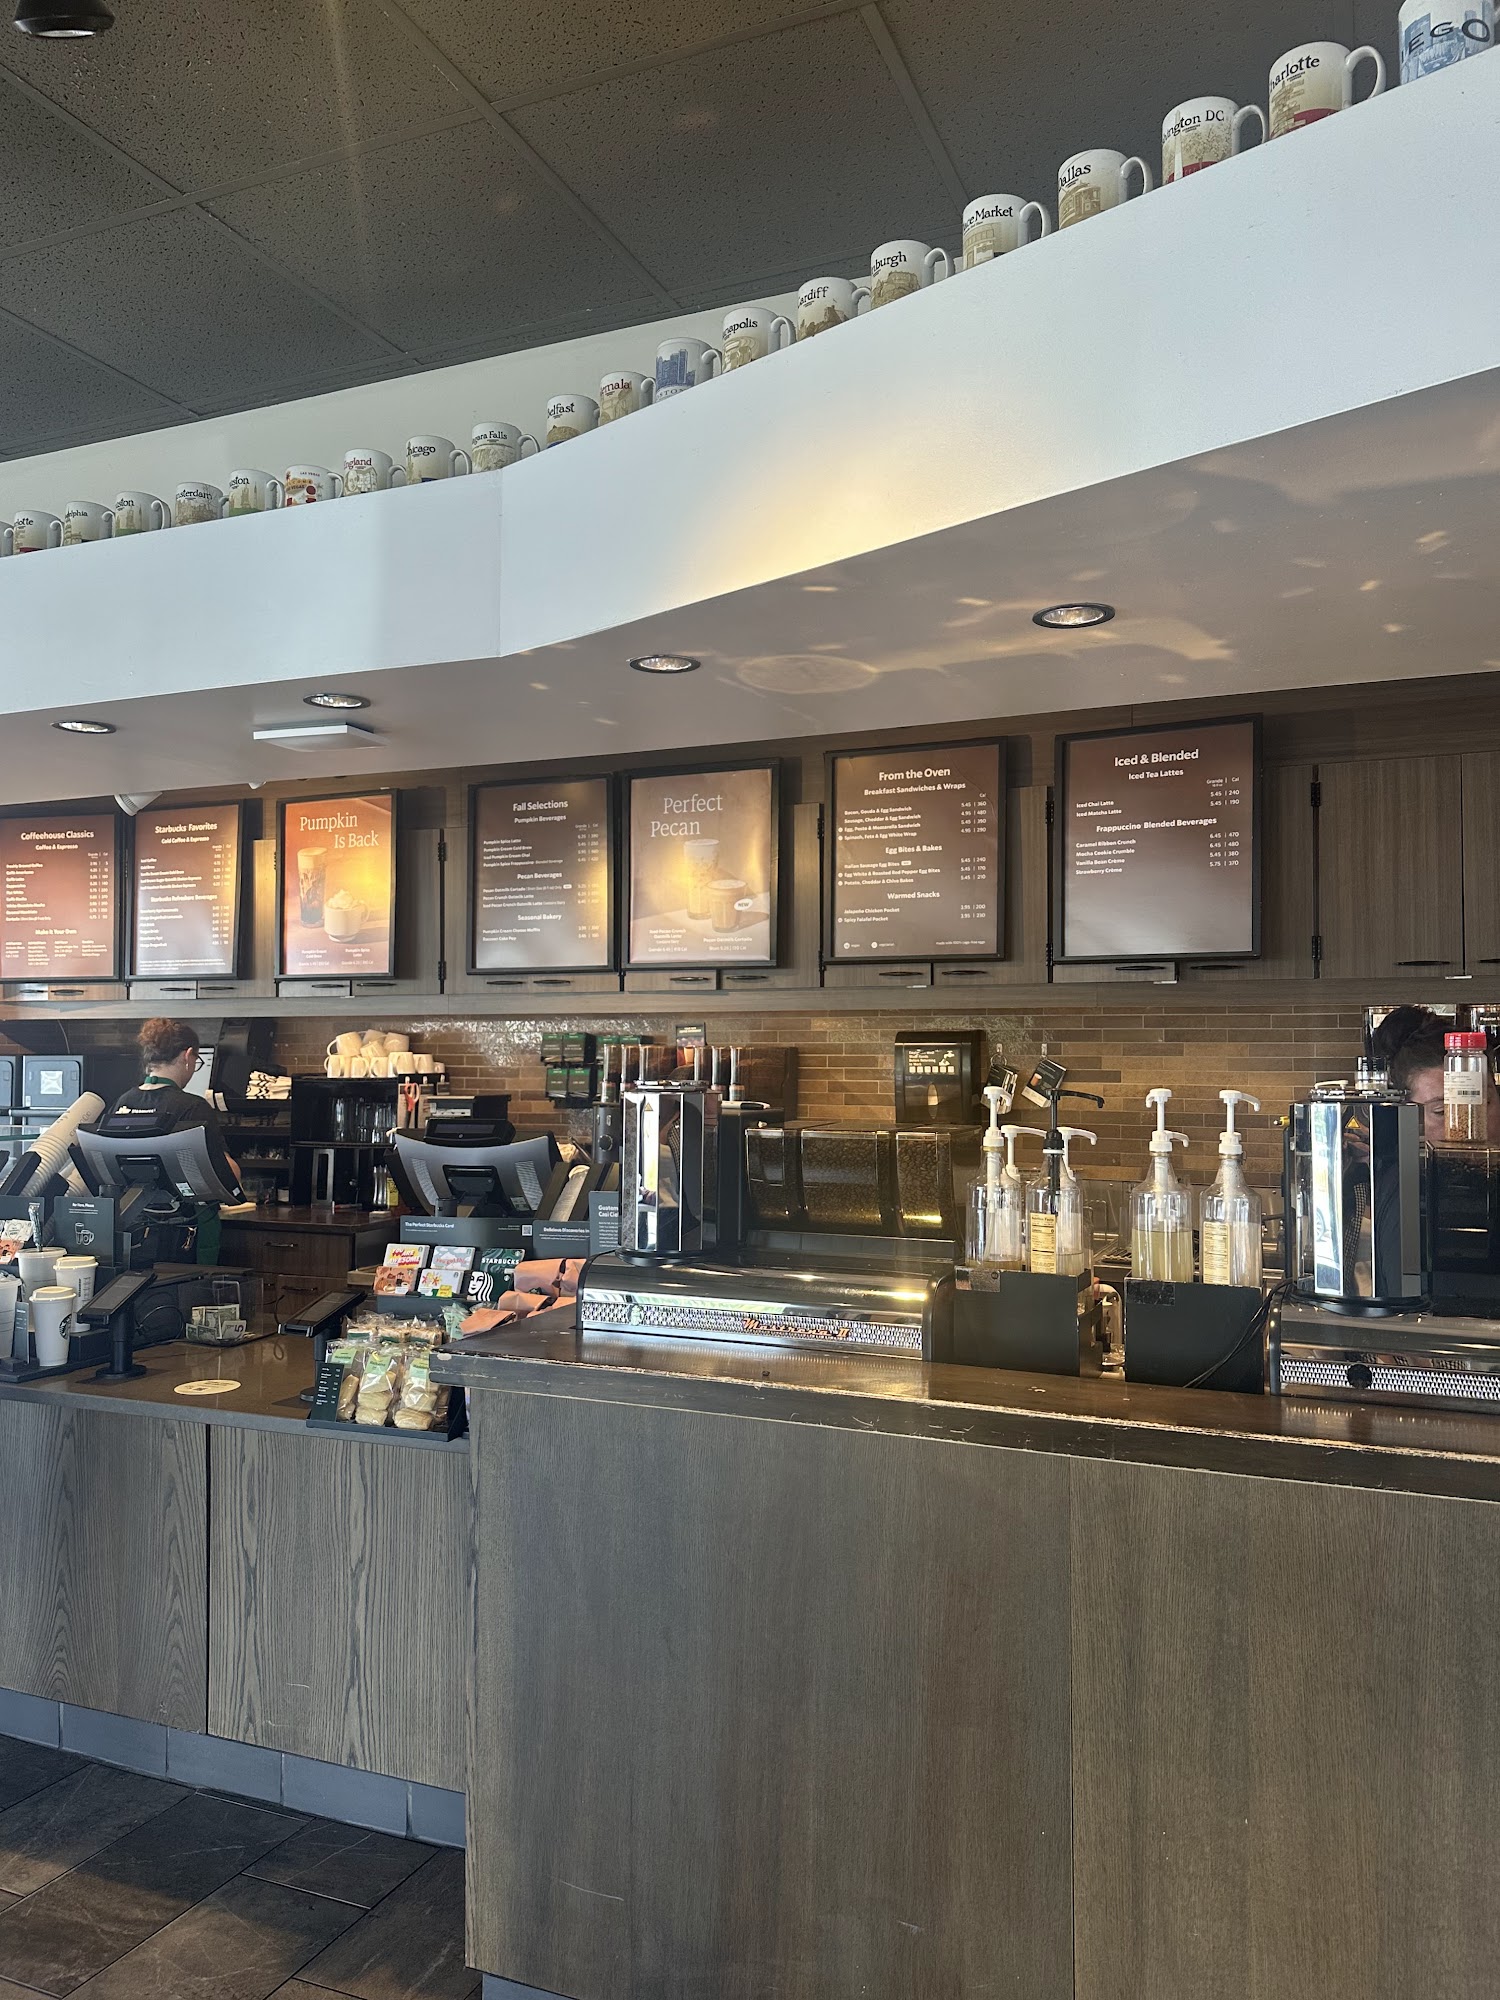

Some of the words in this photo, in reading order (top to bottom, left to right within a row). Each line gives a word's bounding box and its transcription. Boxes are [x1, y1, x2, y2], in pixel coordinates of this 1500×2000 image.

[1205, 110, 1225, 121] DC
[974, 204, 1014, 221] Market
[489, 431, 508, 440] Falls
[1114, 754, 1138, 767] Iced
[1140, 754, 1149, 764] &
[1151, 749, 1200, 763] Blended
[879, 772, 904, 781] From
[906, 769, 923, 778] the
[924, 768, 951, 778] Oven
[1128, 772, 1145, 780] Iced
[1146, 770, 1159, 778] Tea
[864, 787, 896, 796] Breakfast
[896, 783, 936, 794] Sandwiches
[512, 802, 526, 812] Fall
[527, 800, 568, 810] Selections
[664, 794, 723, 814] Perfect
[300, 812, 358, 832] Pumpkin
[514, 816, 538, 824] Pumpkin
[1096, 823, 1142, 833] Frappuccino
[1144, 820, 1176, 829] Blended
[1176, 818, 1218, 826] Beverages
[154, 824, 186, 834] Starbucks
[188, 822, 218, 832] Favorites
[650, 820, 700, 838] Pecan
[20, 831, 66, 840] Coffeehouse
[66, 830, 94, 838] Classics
[334, 834, 346, 848] Is
[348, 830, 379, 848] Back
[886, 846, 898, 854] Egg
[922, 844, 943, 852] Bakes
[887, 892, 916, 900] Warmed
[916, 890, 940, 898] Snacks
[482, 1258, 520, 1266] STARBUCKS
[742, 1318, 832, 1336] Mastrena
